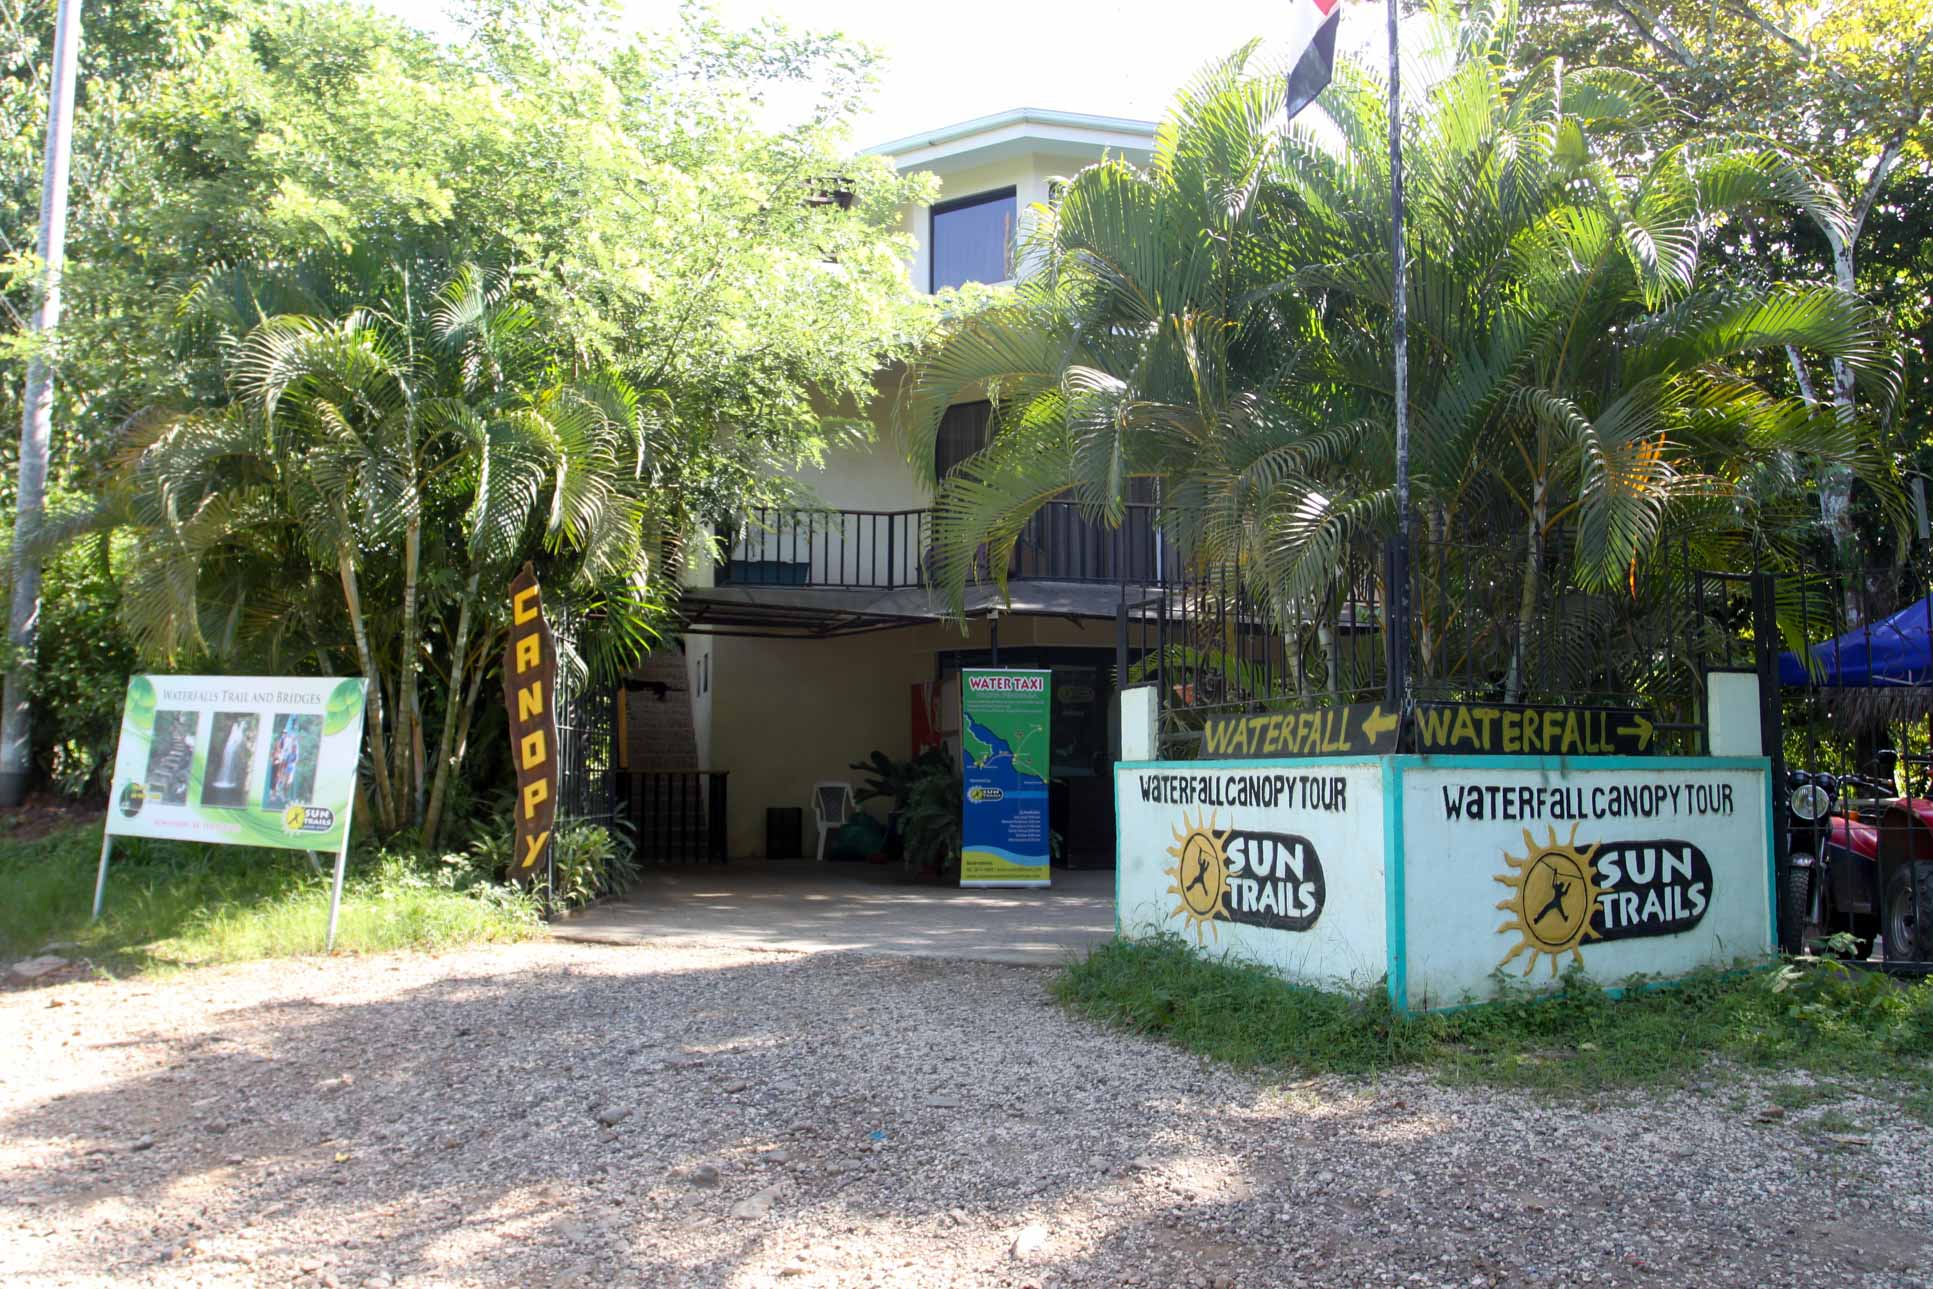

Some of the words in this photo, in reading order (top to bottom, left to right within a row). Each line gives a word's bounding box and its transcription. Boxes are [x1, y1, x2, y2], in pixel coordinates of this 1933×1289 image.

[275, 690, 321, 705] BRIDGES
[969, 676, 1011, 690] WATER
[1013, 676, 1044, 691] TAXI
[514, 584, 549, 867] CANOPY
[1204, 706, 1353, 755] WATERFALL
[1415, 705, 1615, 754] WATERFALL
[304, 808, 330, 818] SUN
[1301, 776, 1347, 812] TOUR
[1684, 783, 1735, 815] TOUR
[1225, 836, 1304, 882] SUN
[1597, 847, 1693, 890] SUN
[1225, 876, 1316, 918] TRAILS
[1597, 882, 1707, 929] TRAILS
